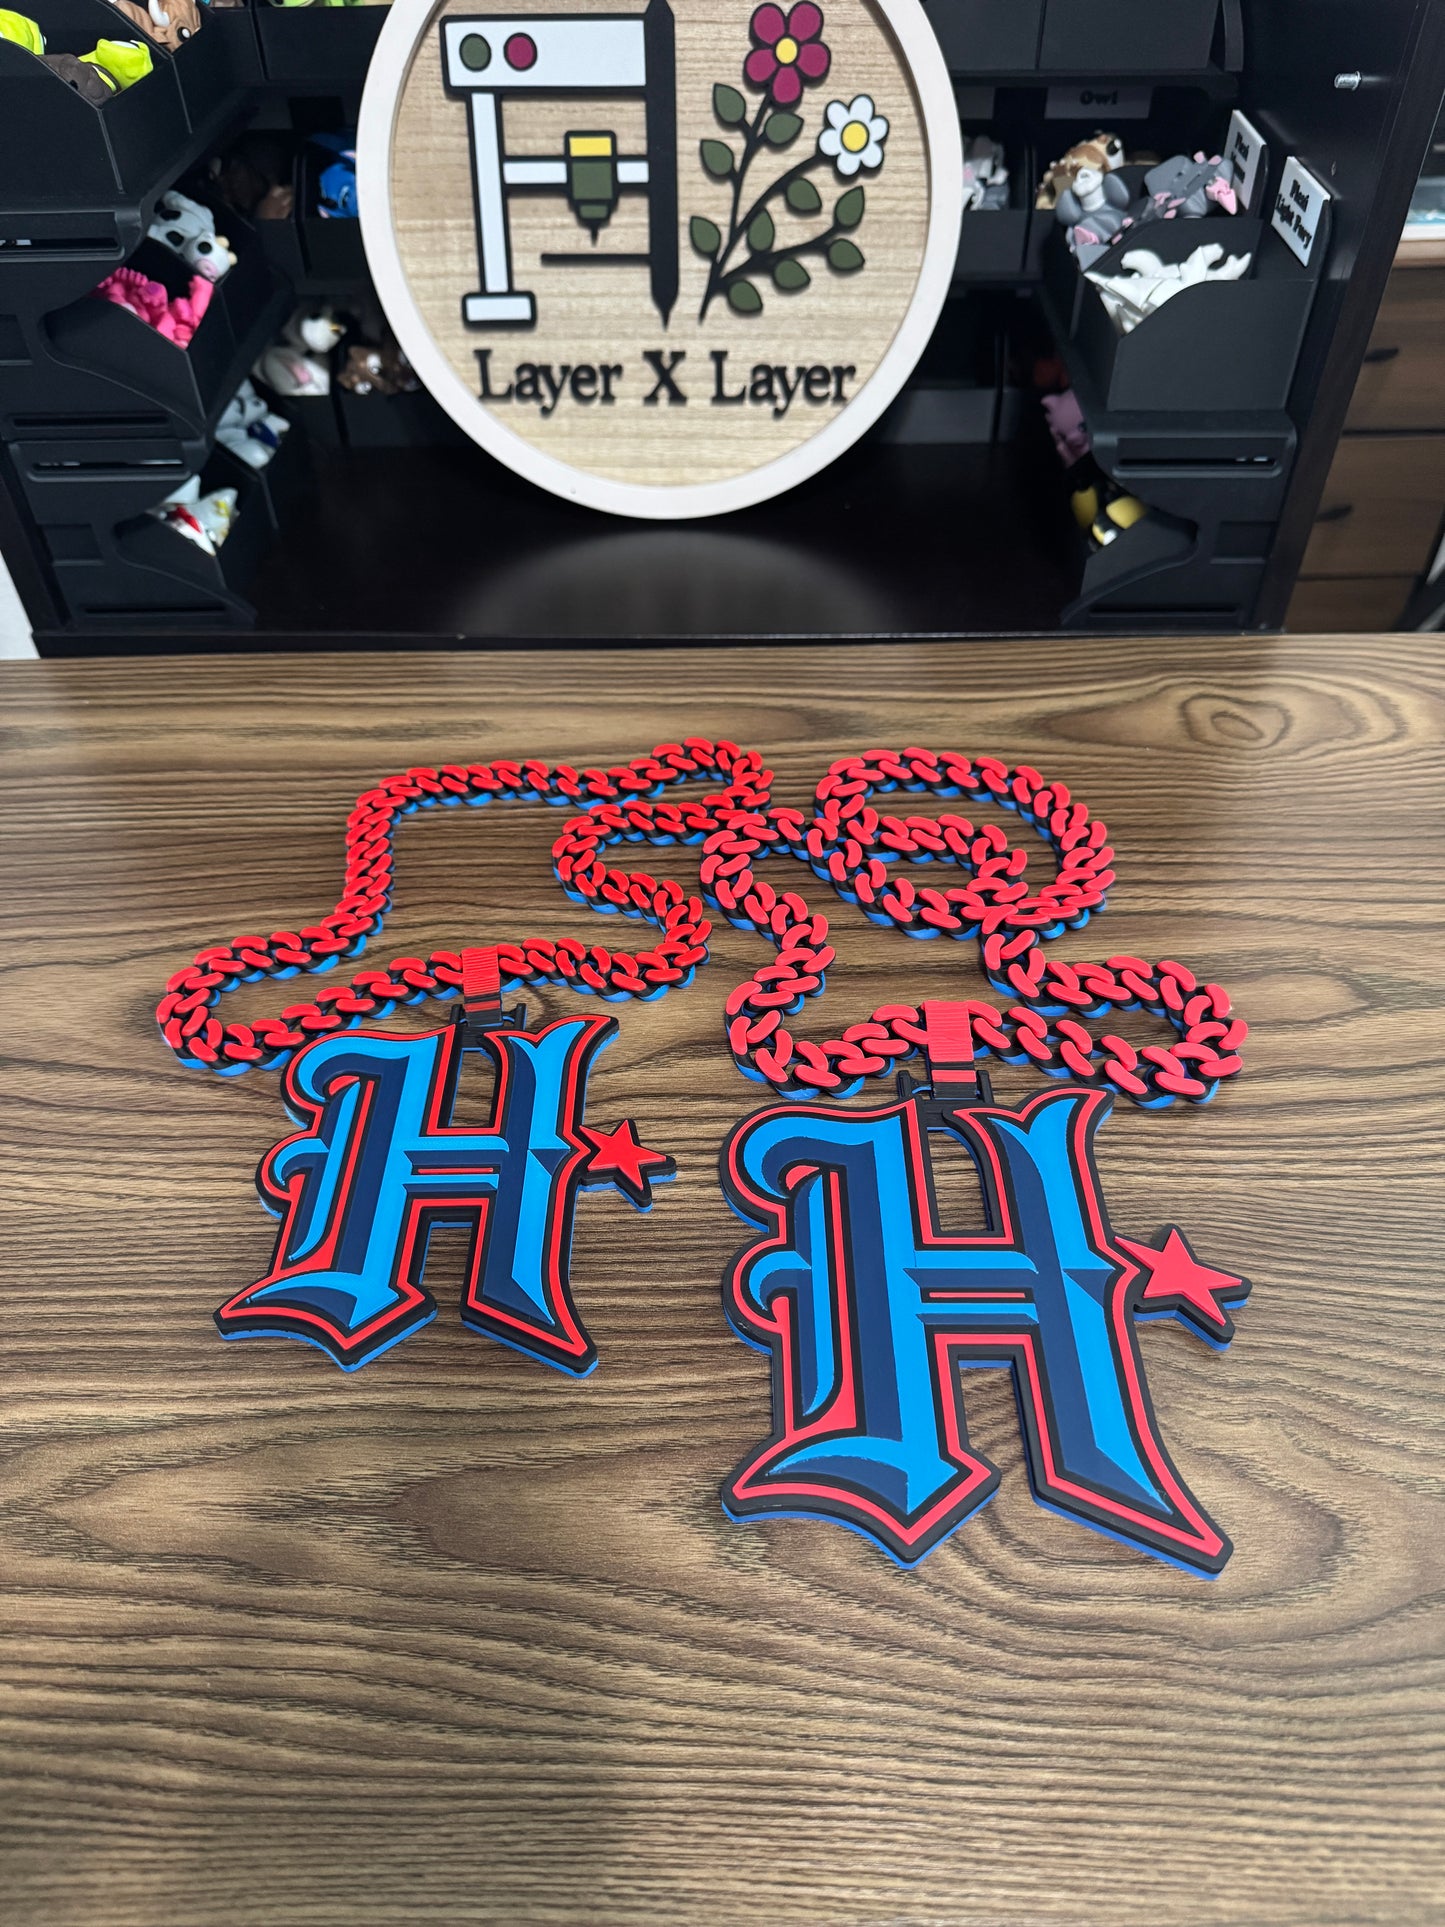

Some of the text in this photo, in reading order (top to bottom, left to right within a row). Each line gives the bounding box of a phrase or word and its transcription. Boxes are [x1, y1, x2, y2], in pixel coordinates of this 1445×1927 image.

[473, 349, 857, 418] Layer X Layer
